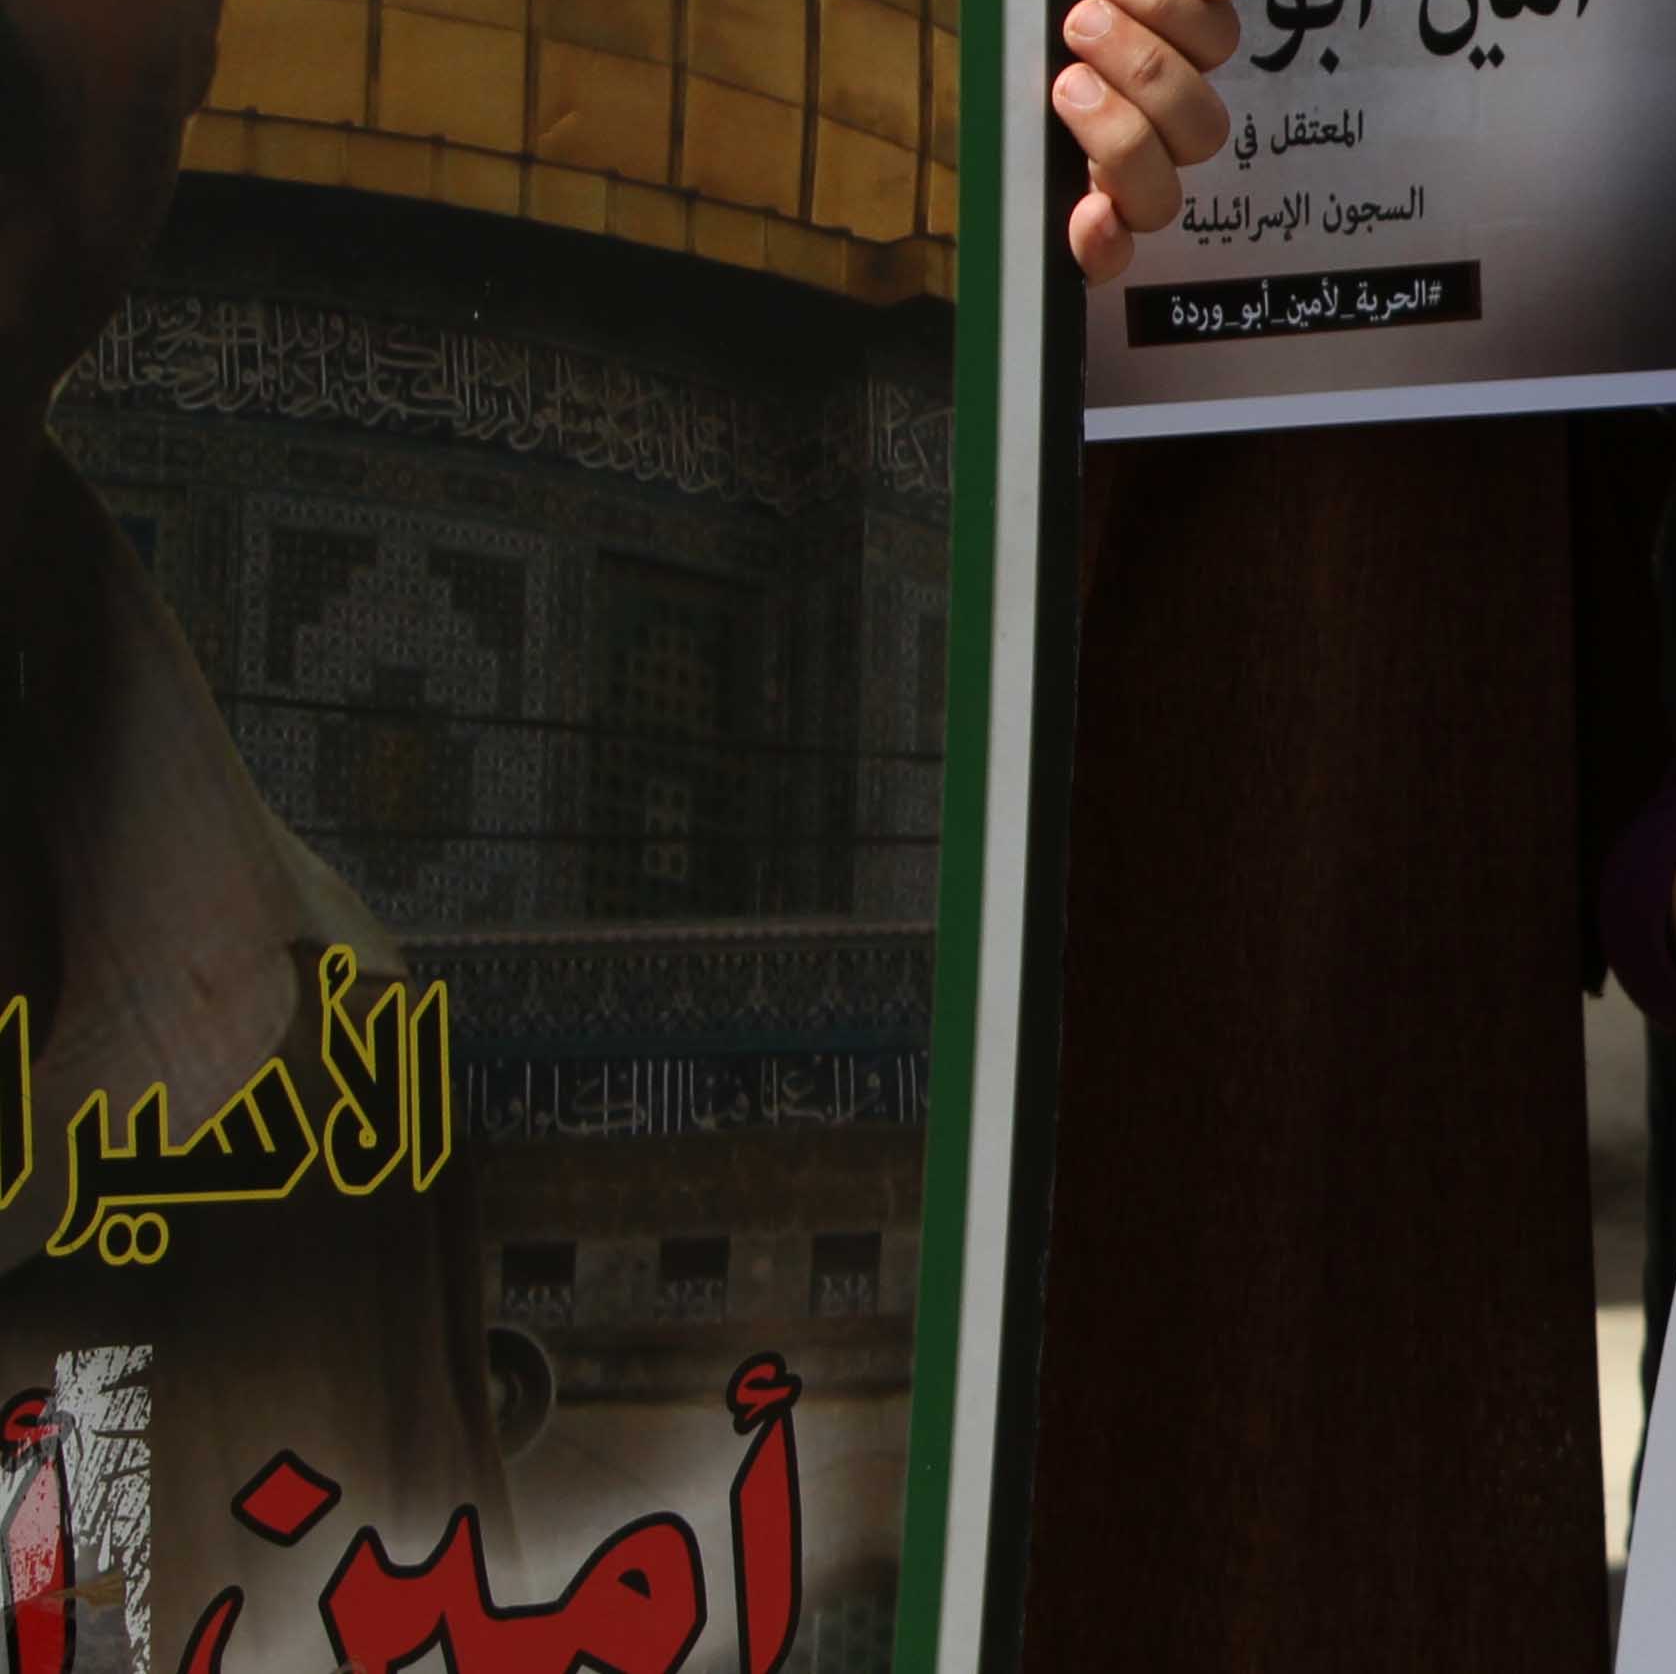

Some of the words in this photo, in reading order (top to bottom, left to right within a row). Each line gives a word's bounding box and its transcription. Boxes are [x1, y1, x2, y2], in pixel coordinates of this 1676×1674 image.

[1233, 115, 1258, 170] في
[1271, 109, 1363, 153] المعتقل
[1181, 192, 1311, 245] الإسرائيلية
[1322, 184, 1424, 235] السجون
[46, 945, 451, 1263] الأسير
